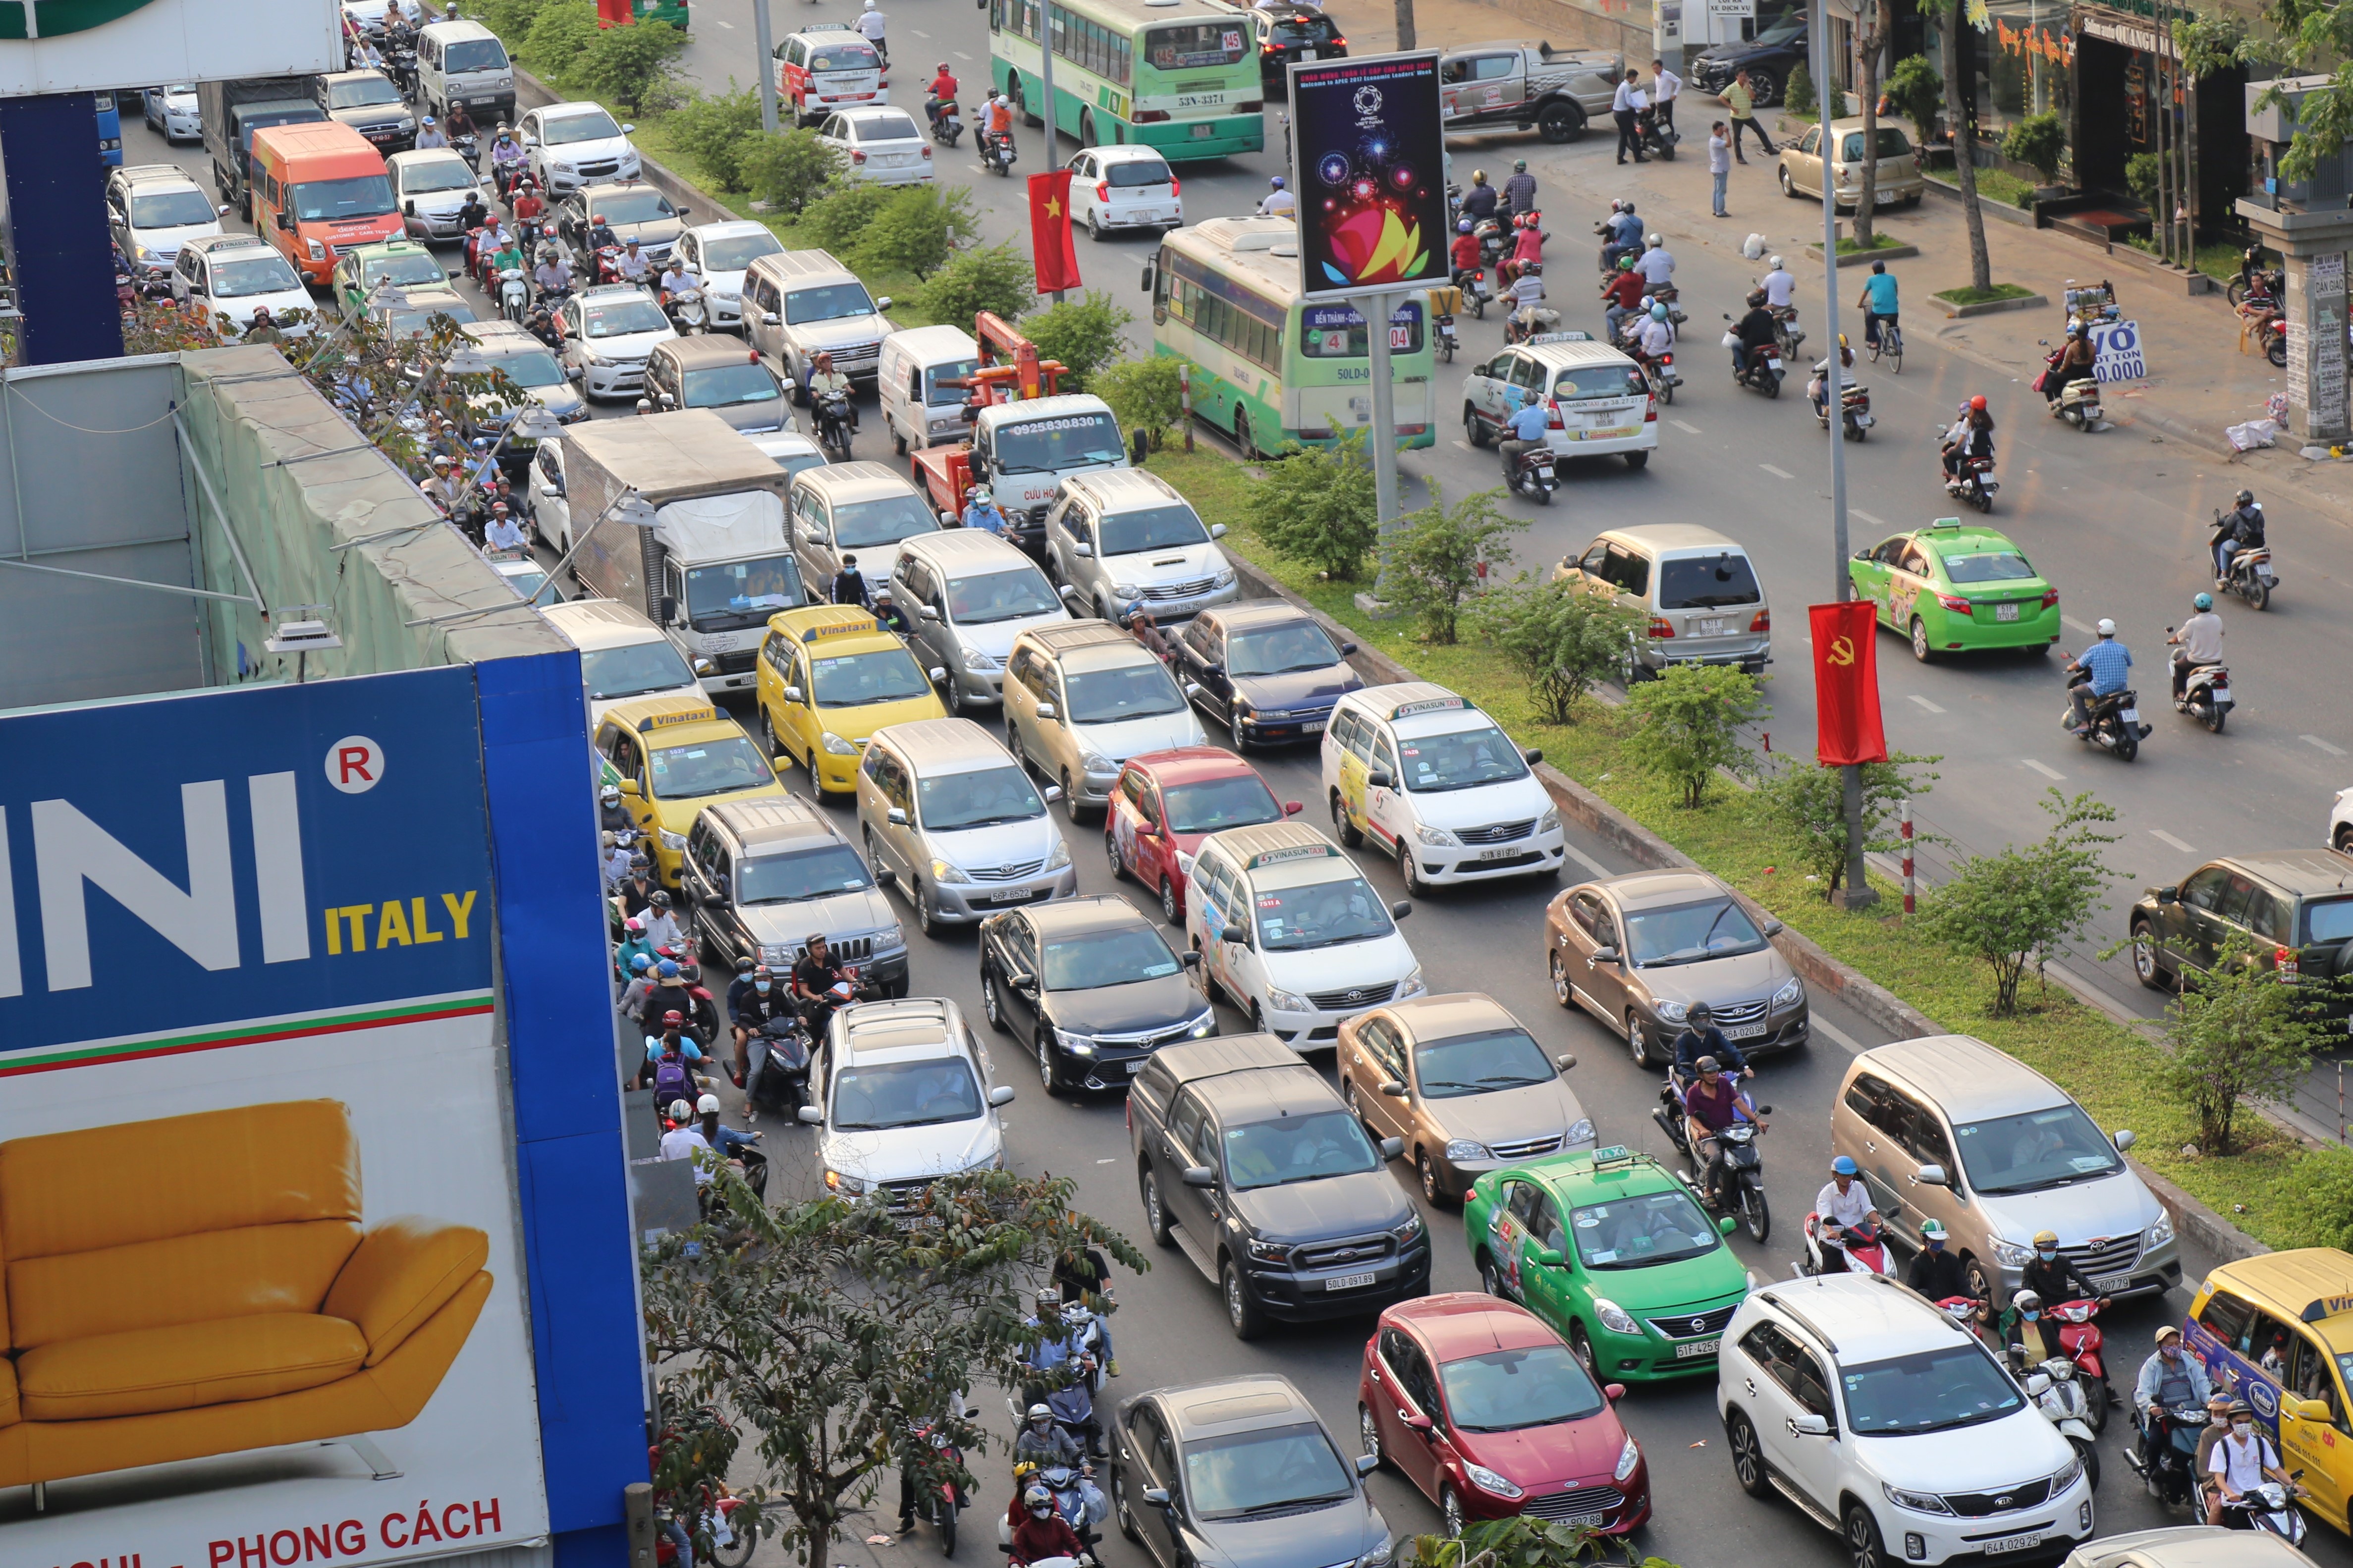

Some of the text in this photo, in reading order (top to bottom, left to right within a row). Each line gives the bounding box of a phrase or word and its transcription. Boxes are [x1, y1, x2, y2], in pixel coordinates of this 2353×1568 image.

[2083, 16, 2101, 35] Salon
[1224, 33, 1238, 48] 145
[1156, 49, 1174, 64] 145
[1398, 63, 1415, 72] APEC
[1179, 94, 1224, 106] 53N-3374
[1315, 310, 1327, 324] BẾN
[1327, 310, 1345, 323] THÀNH
[1349, 312, 1363, 324] CỘNG
[1328, 334, 1339, 348] 4
[1390, 329, 1406, 347] 04
[1014, 416, 1094, 435] 0925.830.830
[1166, 602, 1200, 614] 60A-234.25
[820, 622, 871, 636] Vinataxi
[1702, 627, 1723, 635] 896.00
[1413, 701, 1445, 711] VINASUN
[657, 709, 710, 725] Vinataxi
[1481, 848, 1519, 861] 51A-819.31
[993, 889, 1029, 901] 56P-6522
[325, 890, 477, 955] ITALY
[1328, 1274, 1372, 1289] 50LD-091.89
[1678, 1341, 1719, 1356] 51F-425.8
[2254, 1391, 2272, 1410] EVEREST
[209, 1499, 502, 1568] PHONG CÁCH
[1987, 1534, 2038, 1553] 64A-029.25
